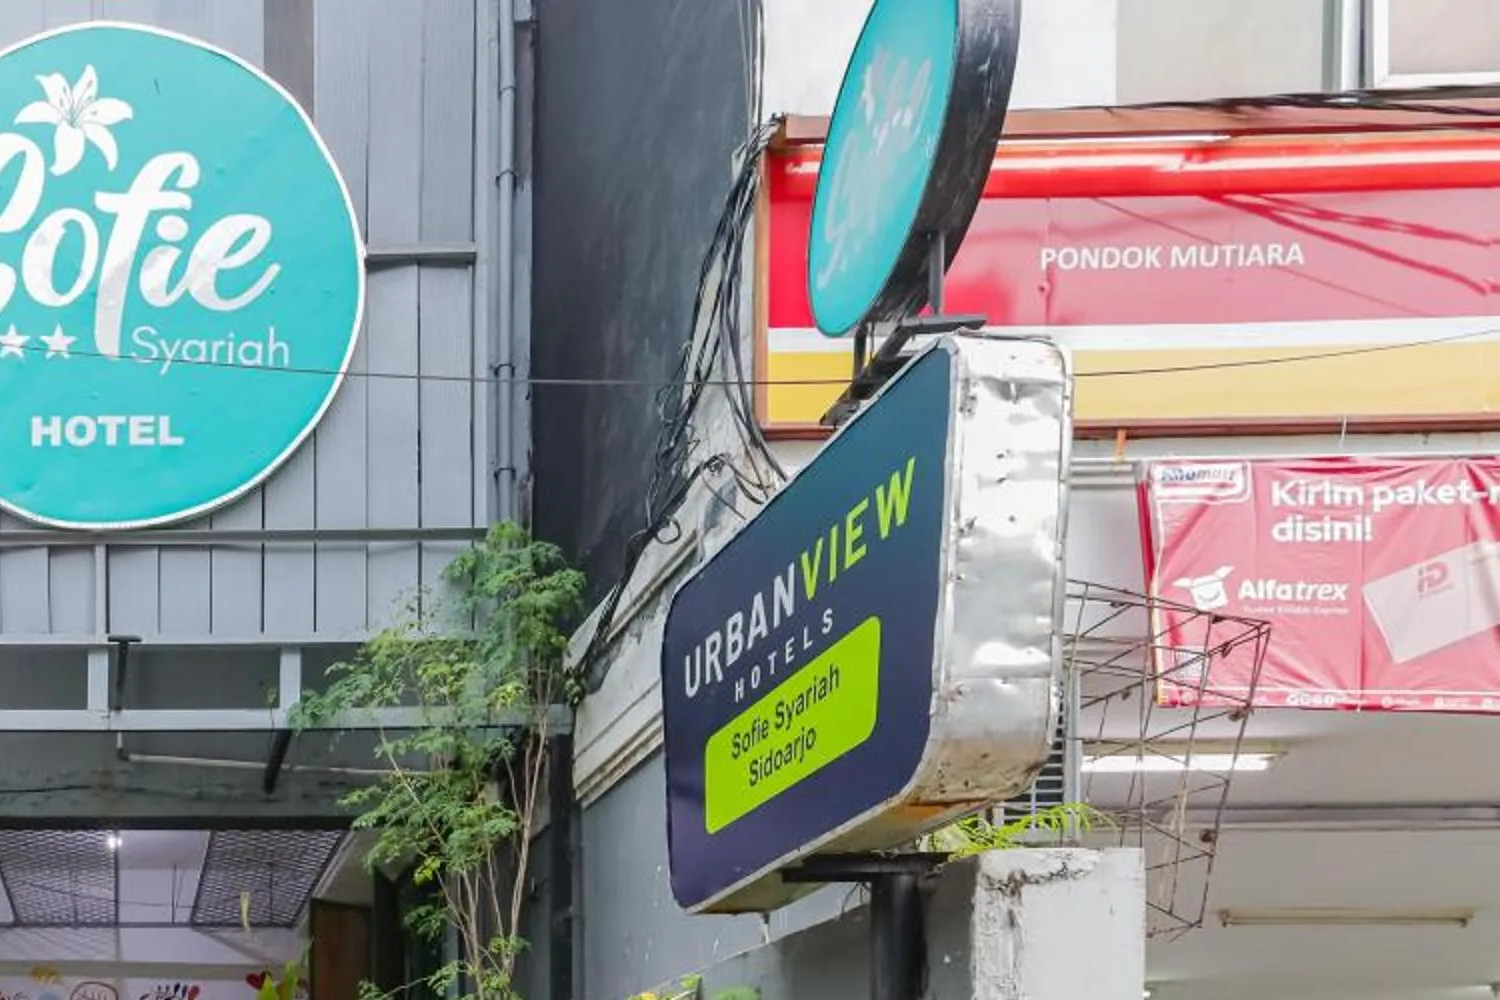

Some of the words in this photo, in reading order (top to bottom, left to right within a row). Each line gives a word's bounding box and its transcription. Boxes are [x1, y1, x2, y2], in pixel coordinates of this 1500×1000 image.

[1039, 245, 1161, 270] PONDOK
[1170, 242, 1305, 268] MUTIARA
[131, 325, 290, 376] Syariah
[30, 415, 185, 446] HOTEL
[1271, 479, 1364, 507] Kirim
[1271, 513, 1373, 543] disini!
[1238, 579, 1350, 602] Alfatrex
[734, 607, 834, 703] HOTELS
[731, 716, 769, 760] Sofie
[775, 664, 840, 731] Syariah
[749, 727, 817, 787] Sidoarjo
